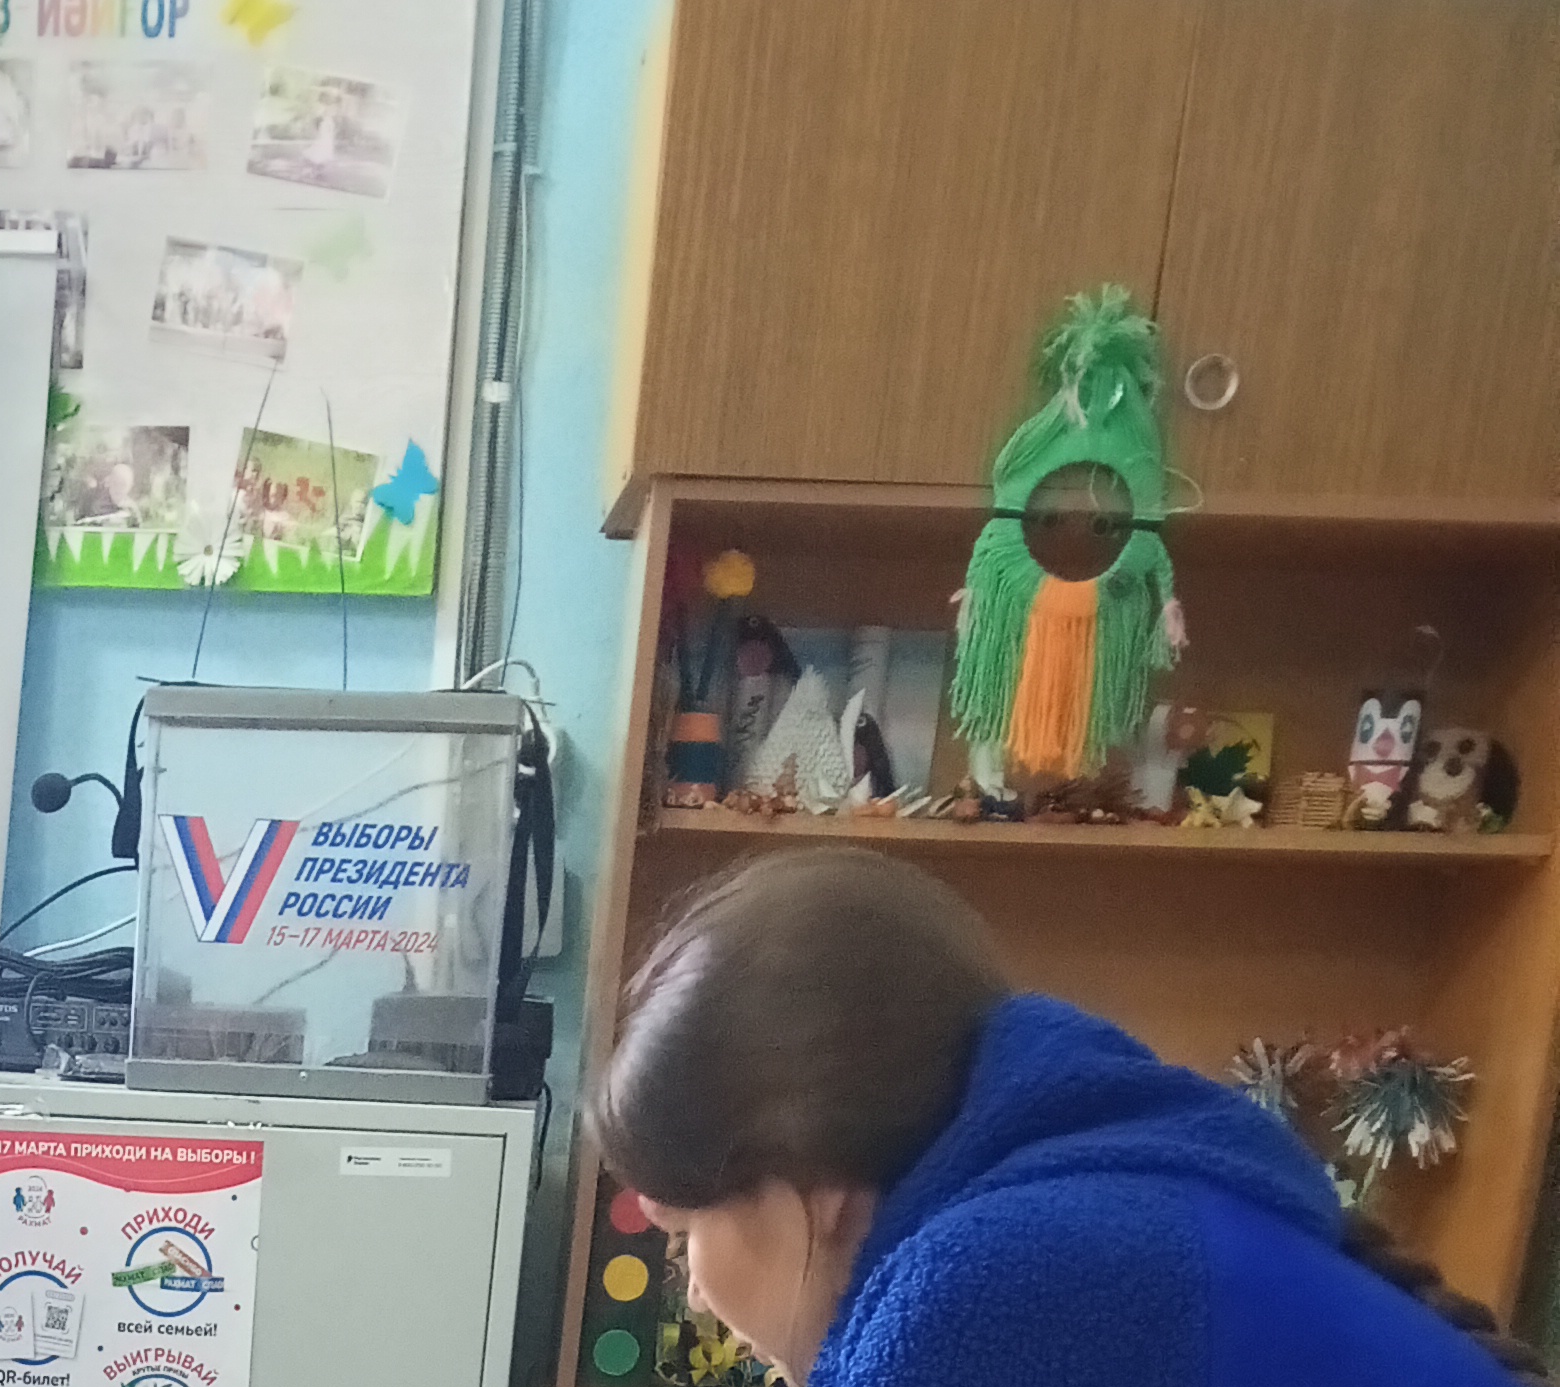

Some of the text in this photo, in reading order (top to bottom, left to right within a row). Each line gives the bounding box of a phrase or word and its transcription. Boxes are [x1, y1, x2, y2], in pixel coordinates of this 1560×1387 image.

[311, 822, 439, 851] ВЫБОРЫ
[294, 857, 470, 890] ПРЕЗИДЕНТА
[278, 892, 393, 921] РОССИИ
[321, 927, 389, 951] МАРТА
[391, 930, 440, 954] 2024
[14, 1140, 66, 1157] МАРТА
[70, 1143, 146, 1162] ПРИХОДИ
[150, 1147, 172, 1161] НА
[121, 1206, 216, 1240] ПРИХОДИ
[117, 1320, 218, 1337] всей семьей!
[103, 1347, 220, 1387] ВЫИГРЫВАЙ
